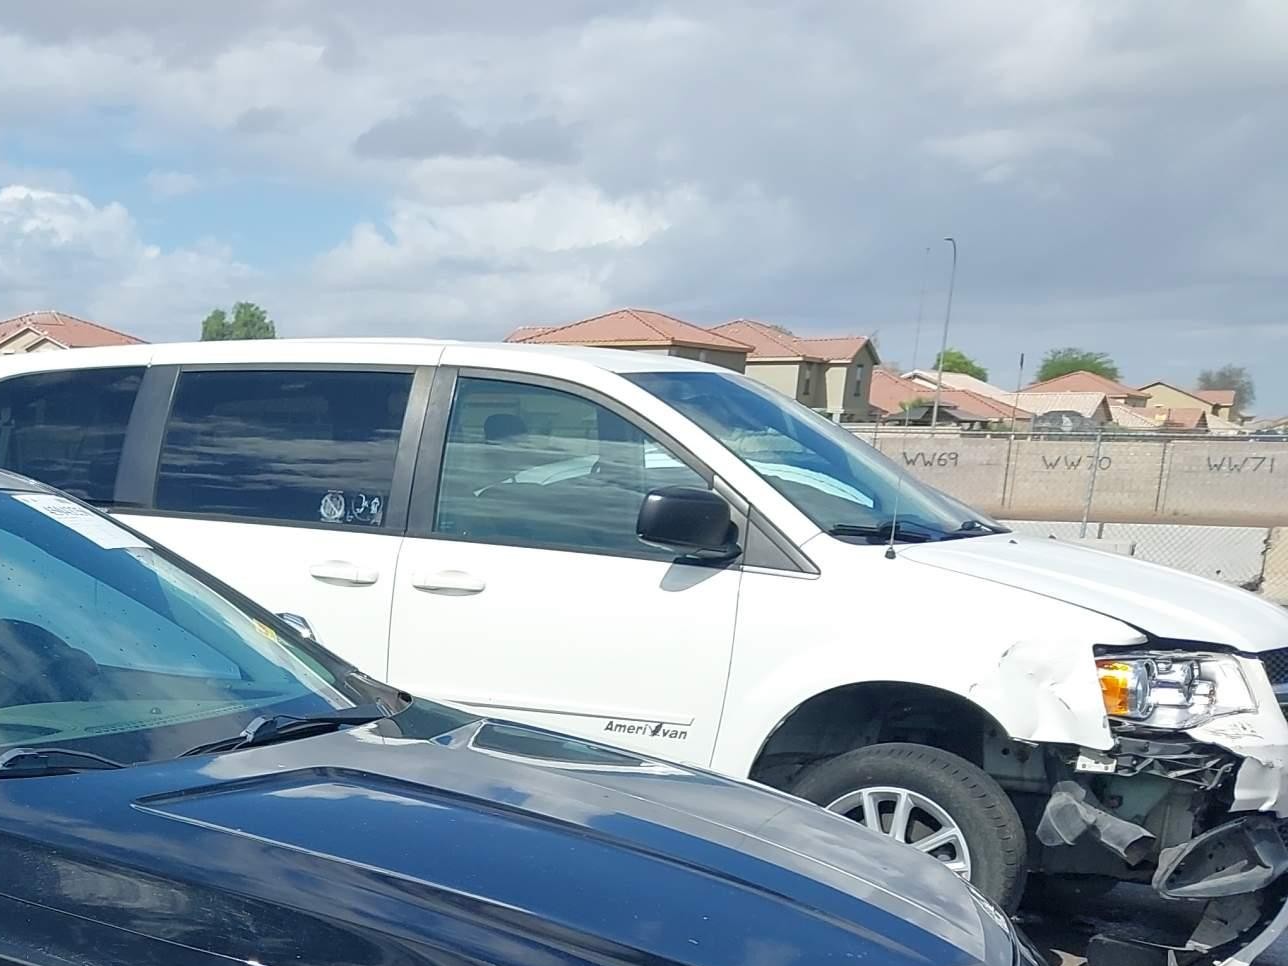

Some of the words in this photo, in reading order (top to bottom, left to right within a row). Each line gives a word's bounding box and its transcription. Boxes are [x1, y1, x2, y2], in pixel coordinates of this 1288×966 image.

[902, 451, 959, 467] WW69
[1041, 455, 1112, 471] WW70
[1207, 456, 1275, 474] WW71
